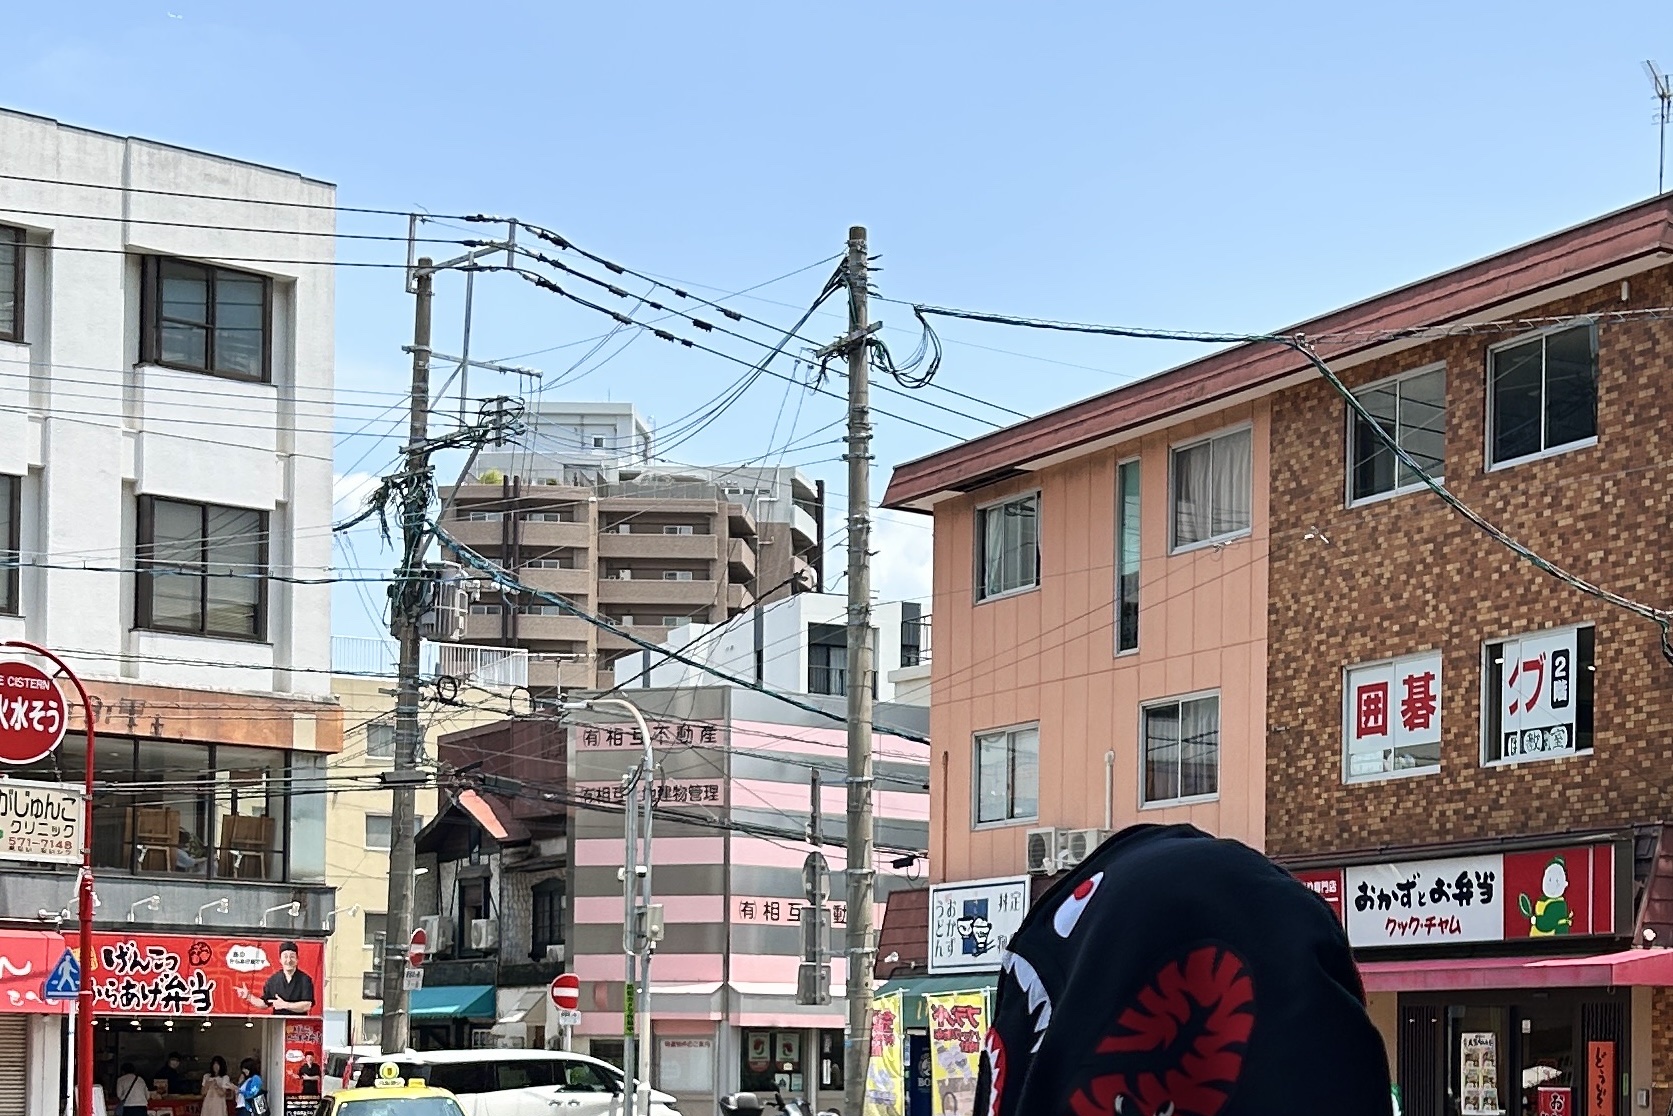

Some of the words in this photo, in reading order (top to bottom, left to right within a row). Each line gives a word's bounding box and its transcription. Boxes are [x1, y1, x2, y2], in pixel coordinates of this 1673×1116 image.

[8, 676, 50, 690] CISTERN
[1356, 671, 1437, 740] 囲碁
[9, 837, 72, 849] 571-7148
[11, 820, 74, 838] クリニック
[1355, 871, 1495, 911] おかずとお弁当
[935, 900, 945, 957] うどん
[947, 899, 957, 957] おかず
[102, 941, 180, 974] げんこつ
